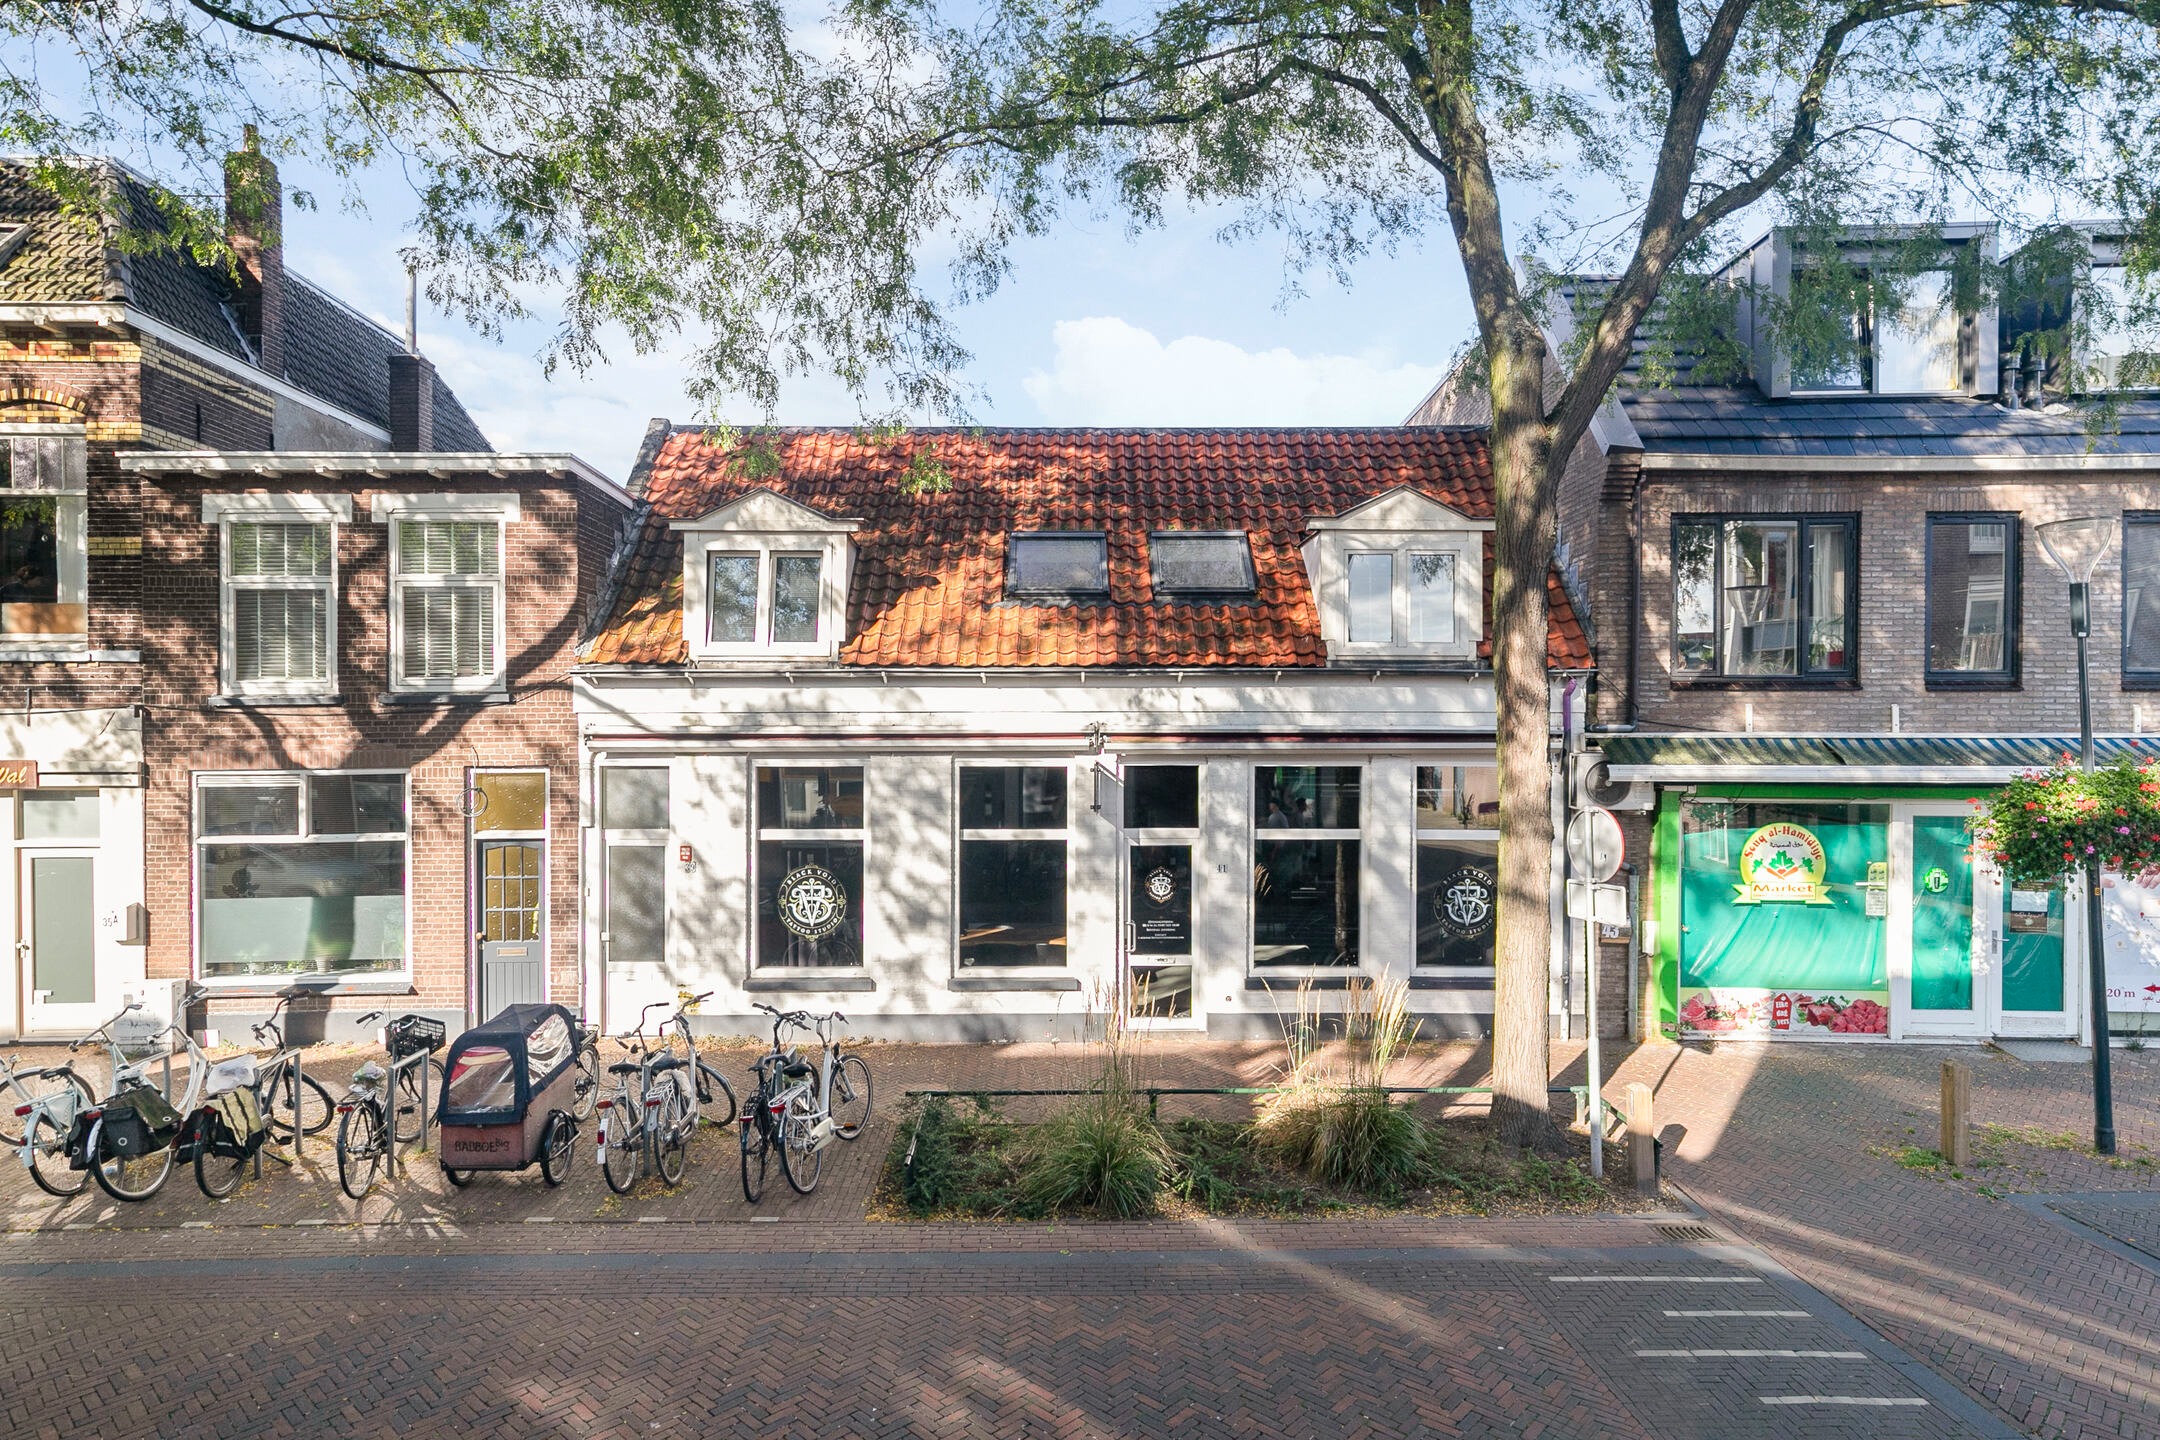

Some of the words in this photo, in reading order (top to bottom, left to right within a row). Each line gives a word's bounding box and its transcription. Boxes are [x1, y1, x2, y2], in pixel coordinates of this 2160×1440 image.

[1743, 834, 1768, 859] Souq
[786, 869, 813, 885] BLACK
[816, 869, 837, 885] VOID
[1472, 869, 1493, 886] VOID
[1753, 884, 1814, 893] Market
[785, 917, 811, 934] TATTOO
[814, 917, 838, 934] STUDIO
[2124, 990, 2136, 998] m
